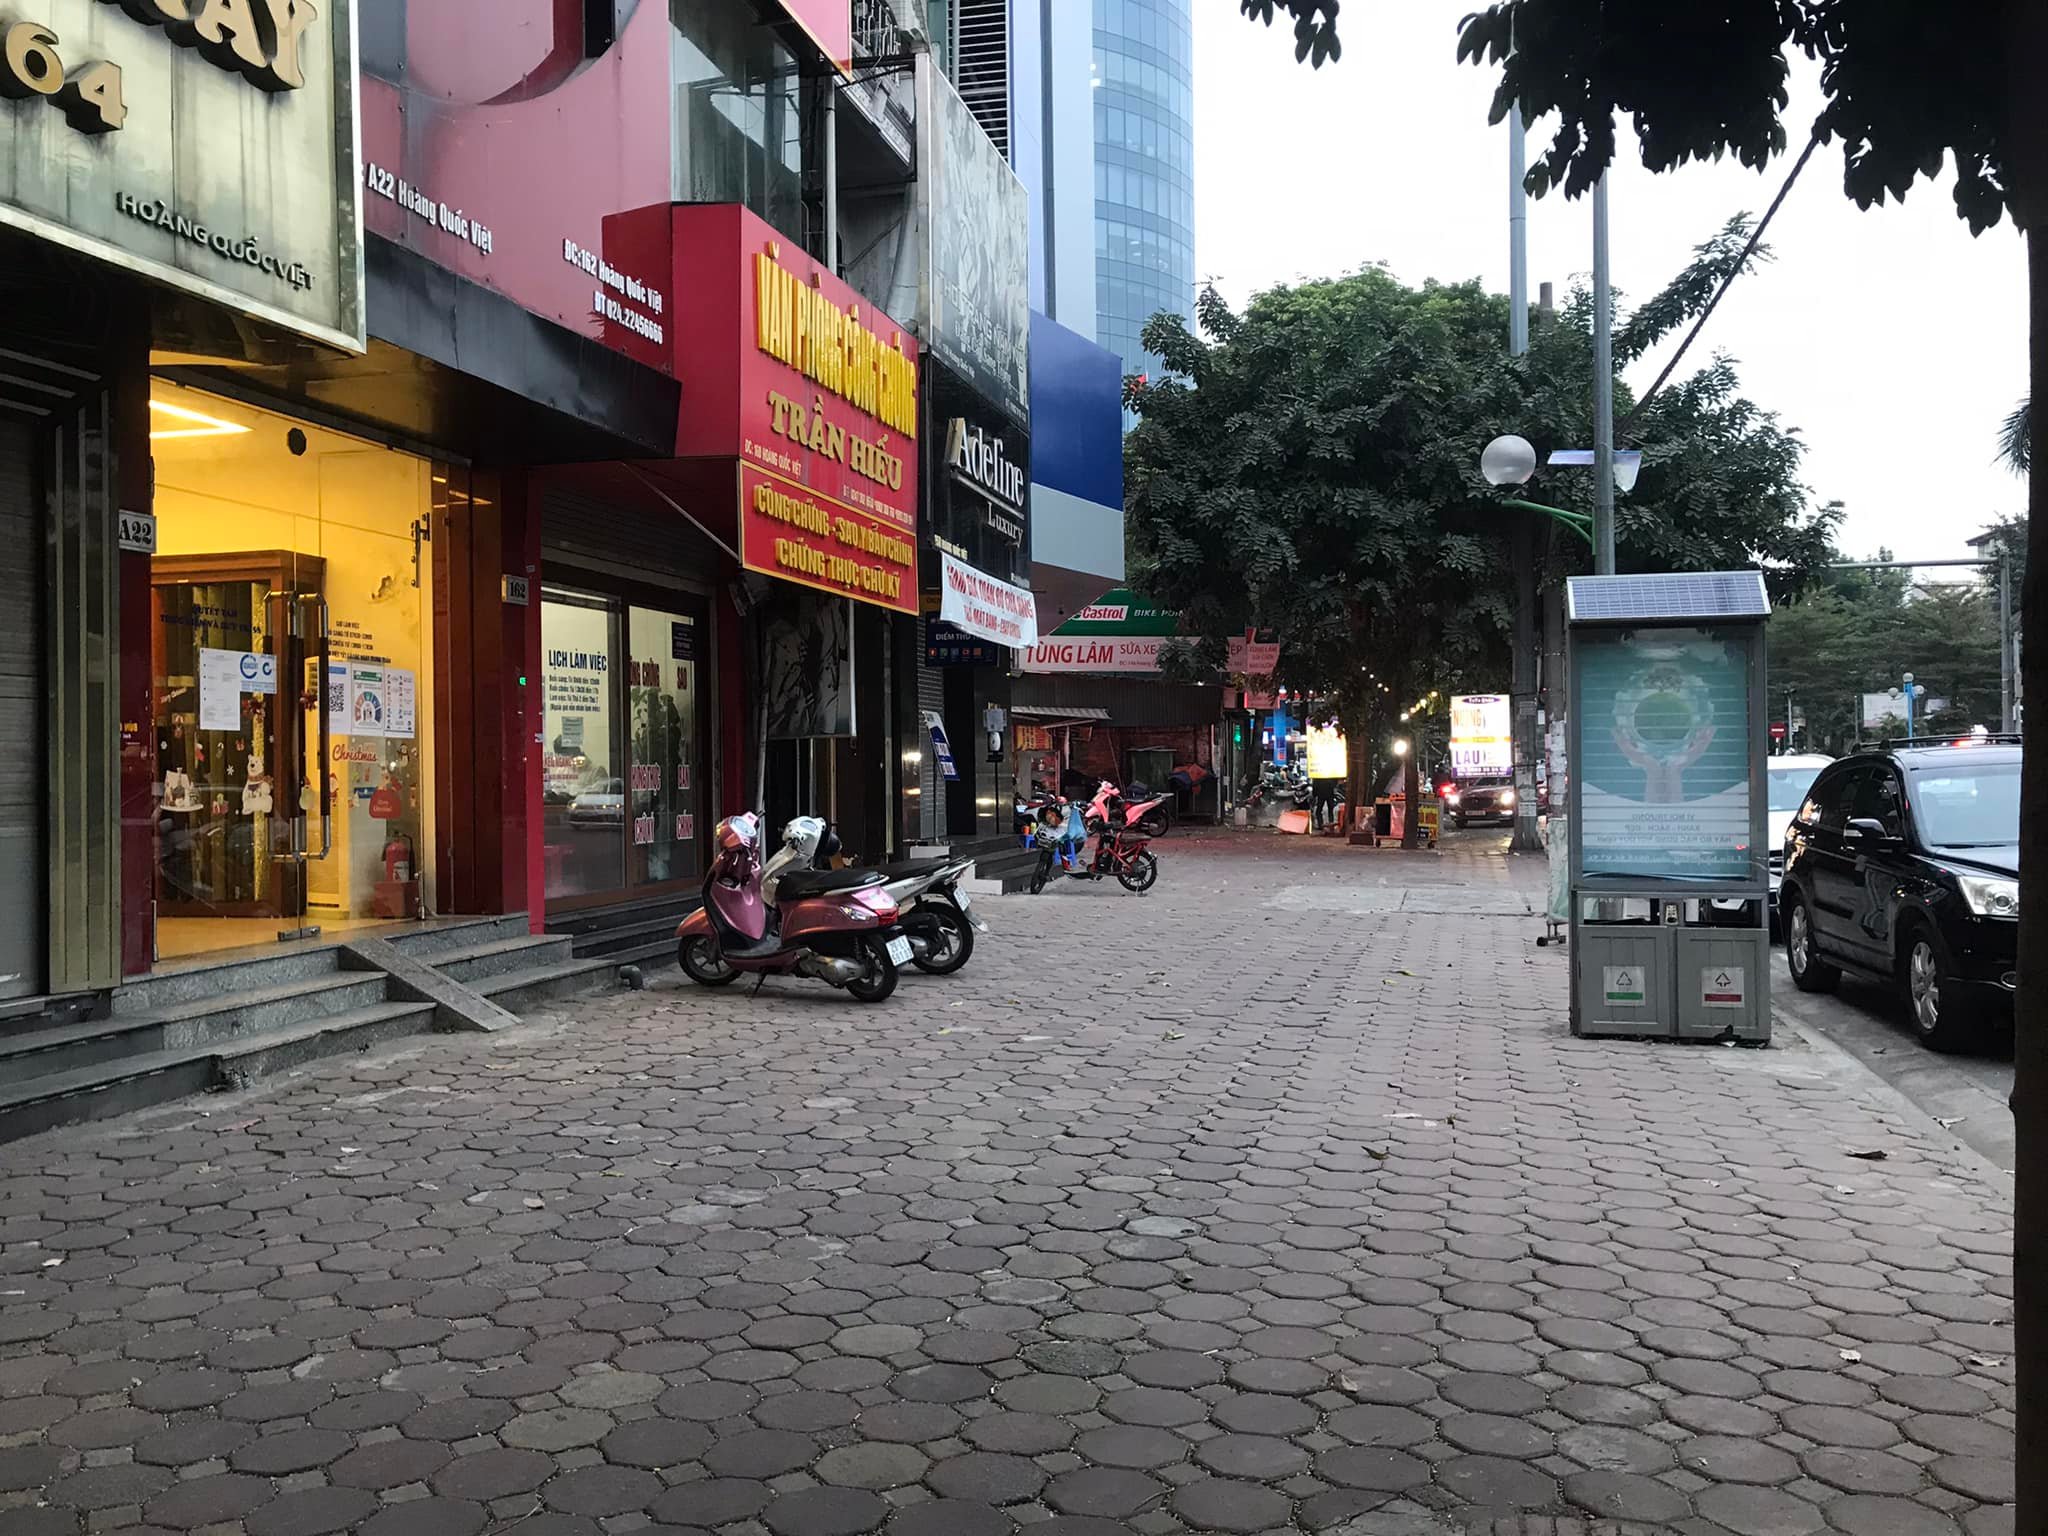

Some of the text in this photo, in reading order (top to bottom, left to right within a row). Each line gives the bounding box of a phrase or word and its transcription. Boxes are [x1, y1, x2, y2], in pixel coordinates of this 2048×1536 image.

[367, 162, 493, 256] A22 Hoàng Quốc Việt
[117, 192, 315, 292] HOÀNG QUỐC VIỆT
[598, 258, 625, 295] Hoàng
[626, 275, 647, 303] Quốc
[647, 287, 663, 315] Việt
[754, 240, 793, 366] VĂN
[793, 272, 843, 396] PHÒNG
[841, 303, 879, 416] CÔNG
[767, 390, 845, 463] TRẦN
[949, 417, 1024, 506] Adeline
[118, 519, 152, 545] A22
[754, 481, 791, 522] CÔNG
[789, 498, 829, 536] CHỨNG
[836, 516, 859, 546] SAO
[987, 501, 1024, 549] Luxury
[776, 537, 827, 576] CHỨNG
[826, 555, 859, 589] THỰC
[1082, 605, 1125, 619] Castrol
[1134, 608, 1157, 617] BIKE
[549, 648, 607, 675] LỊCH LÀM VIỆC
[1026, 640, 1073, 664] TÙNG
[1076, 640, 1114, 664] LÂM
[1143, 644, 1157, 655] XE
[332, 743, 377, 762] Christmas
